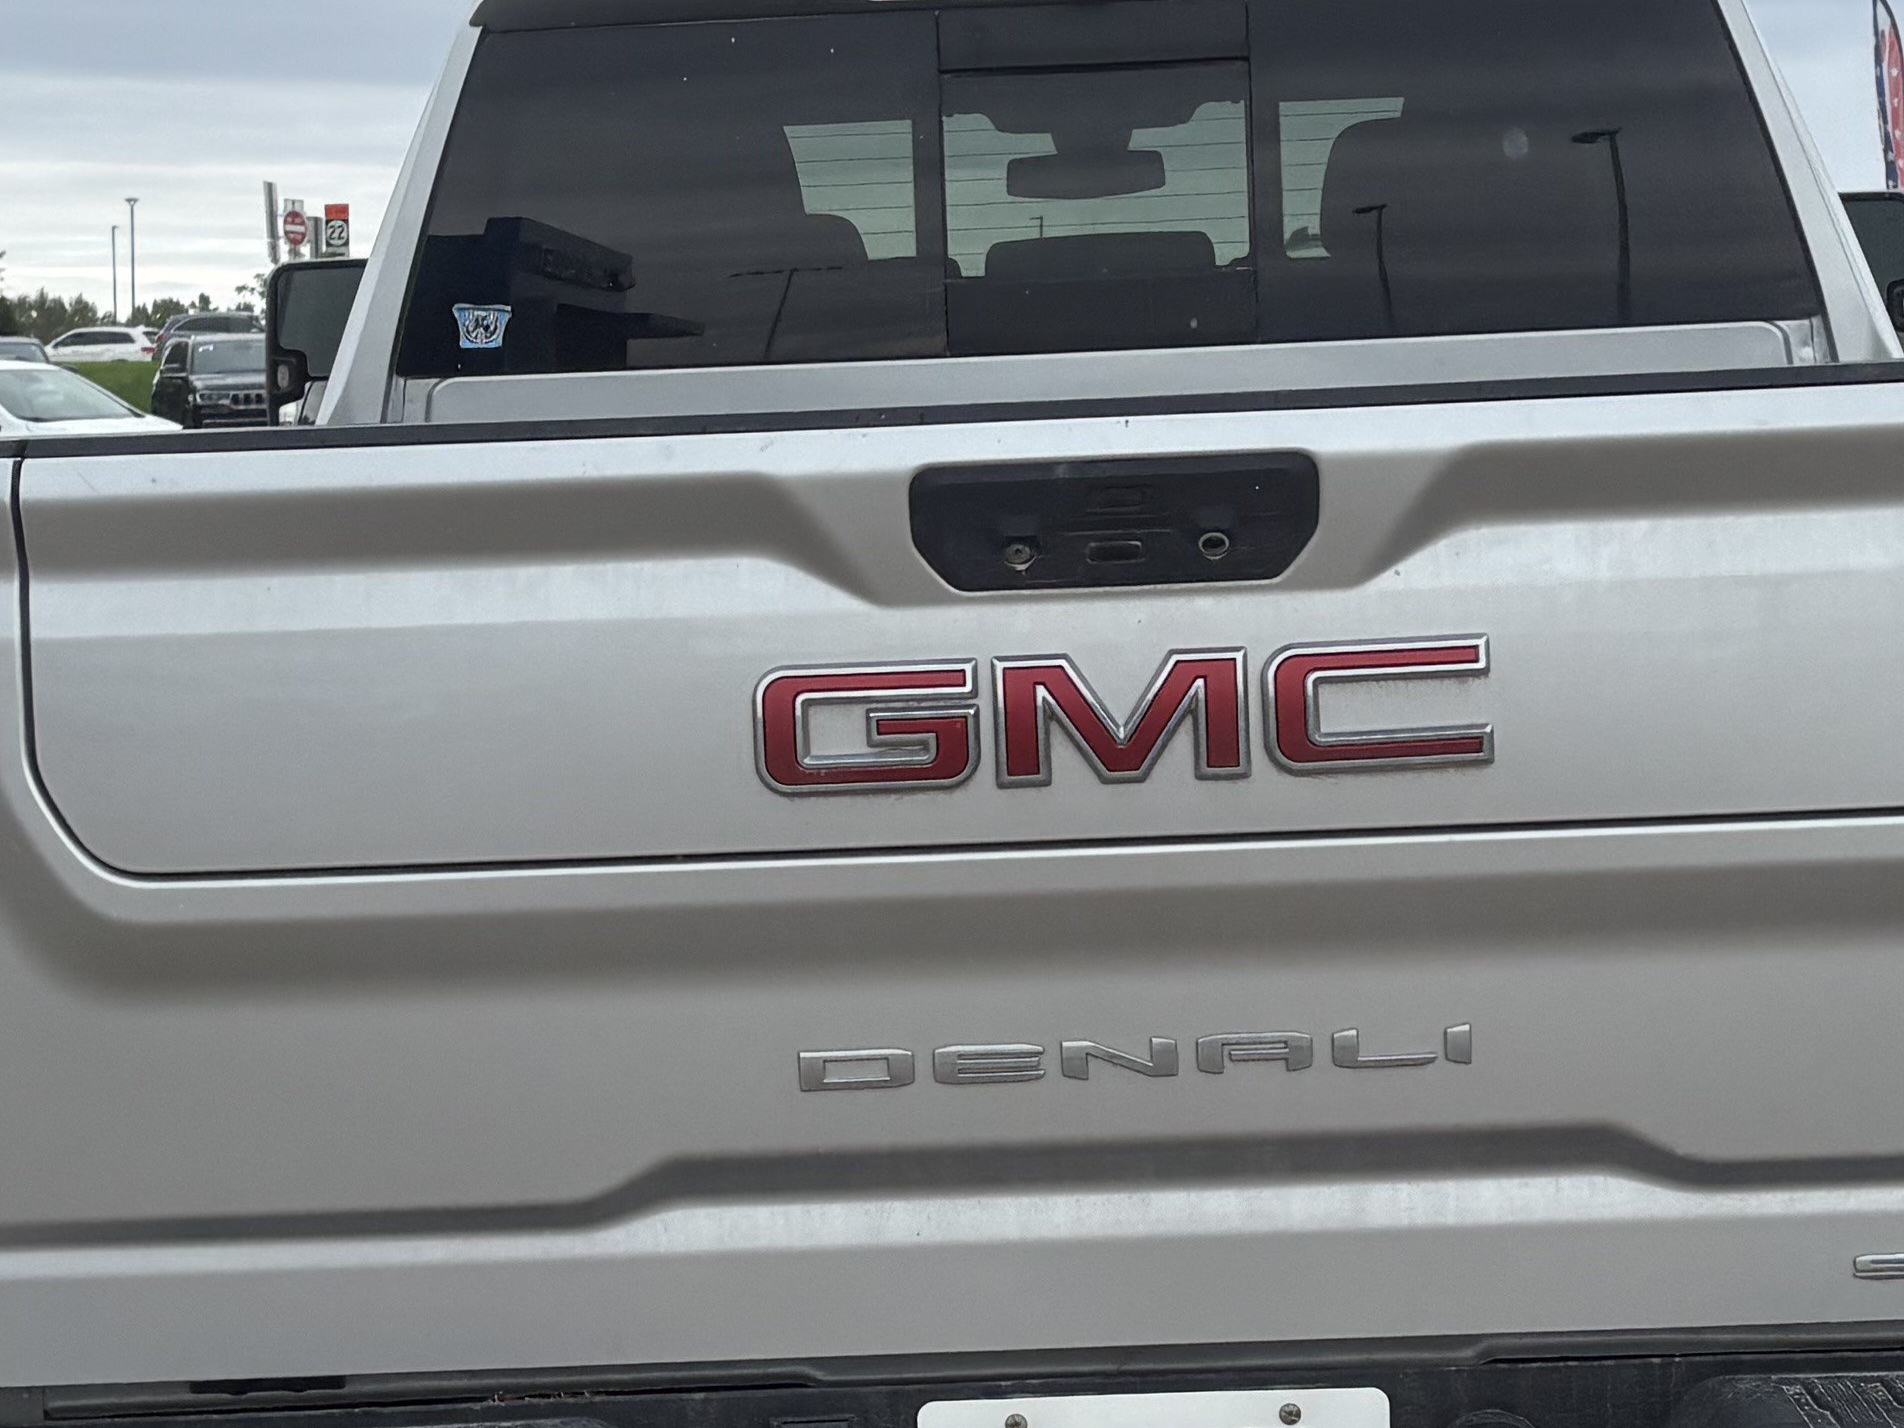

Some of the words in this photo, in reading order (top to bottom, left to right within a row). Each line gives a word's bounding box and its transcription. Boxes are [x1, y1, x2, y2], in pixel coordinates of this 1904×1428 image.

[329, 225, 345, 241] 22
[751, 632, 1496, 797] GMC
[797, 1022, 1473, 1093] DENALI
